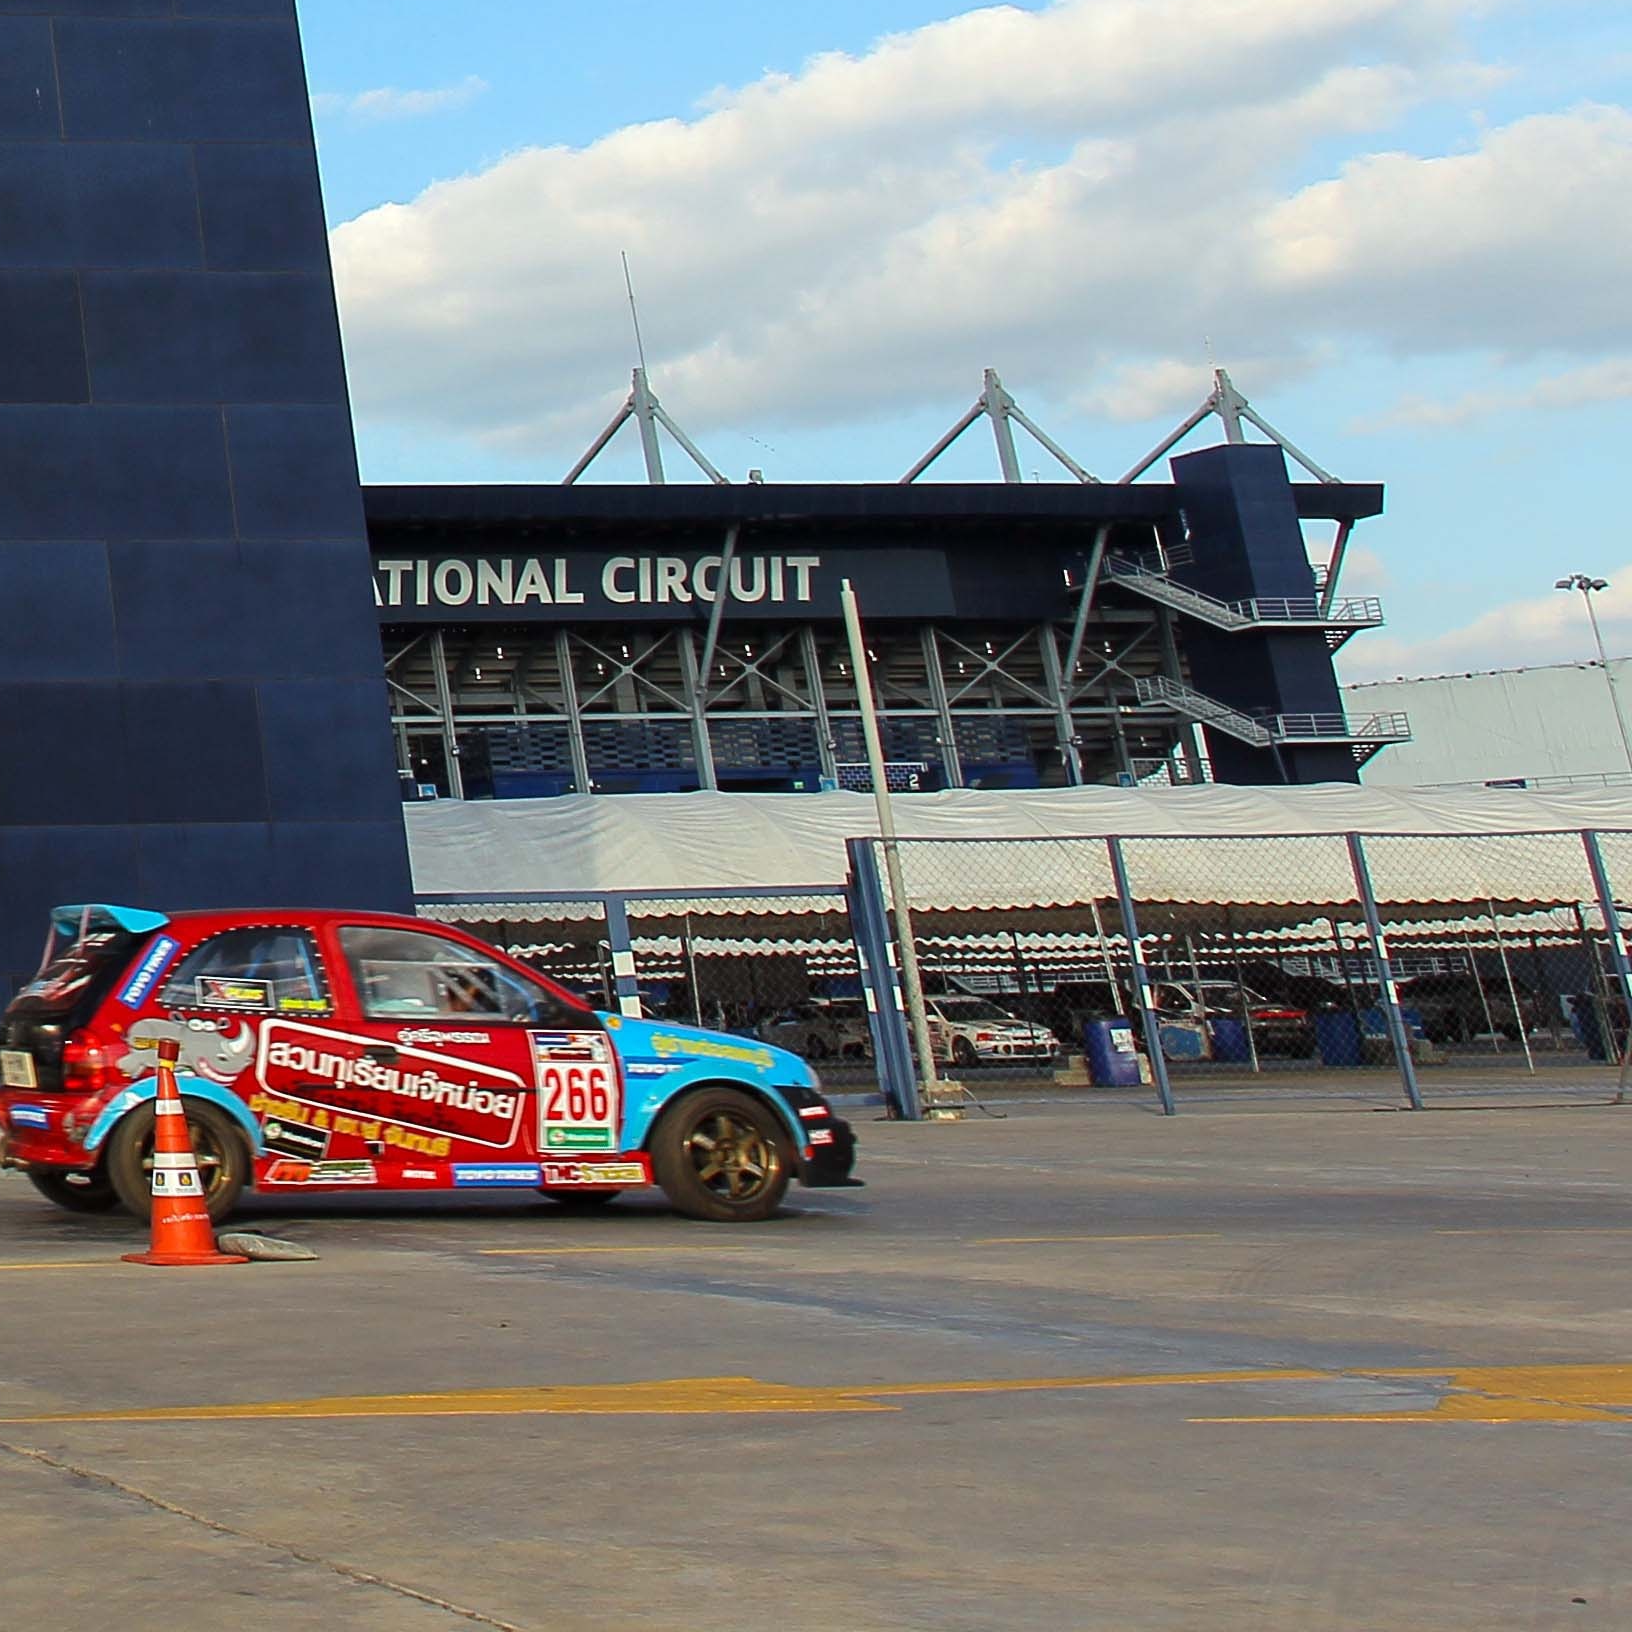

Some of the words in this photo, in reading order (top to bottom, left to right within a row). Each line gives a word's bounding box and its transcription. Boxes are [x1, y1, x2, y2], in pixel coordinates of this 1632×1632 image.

[372, 558, 585, 606] TIONAL
[601, 555, 821, 603] CIRCUIT
[542, 1068, 608, 1121] 266
